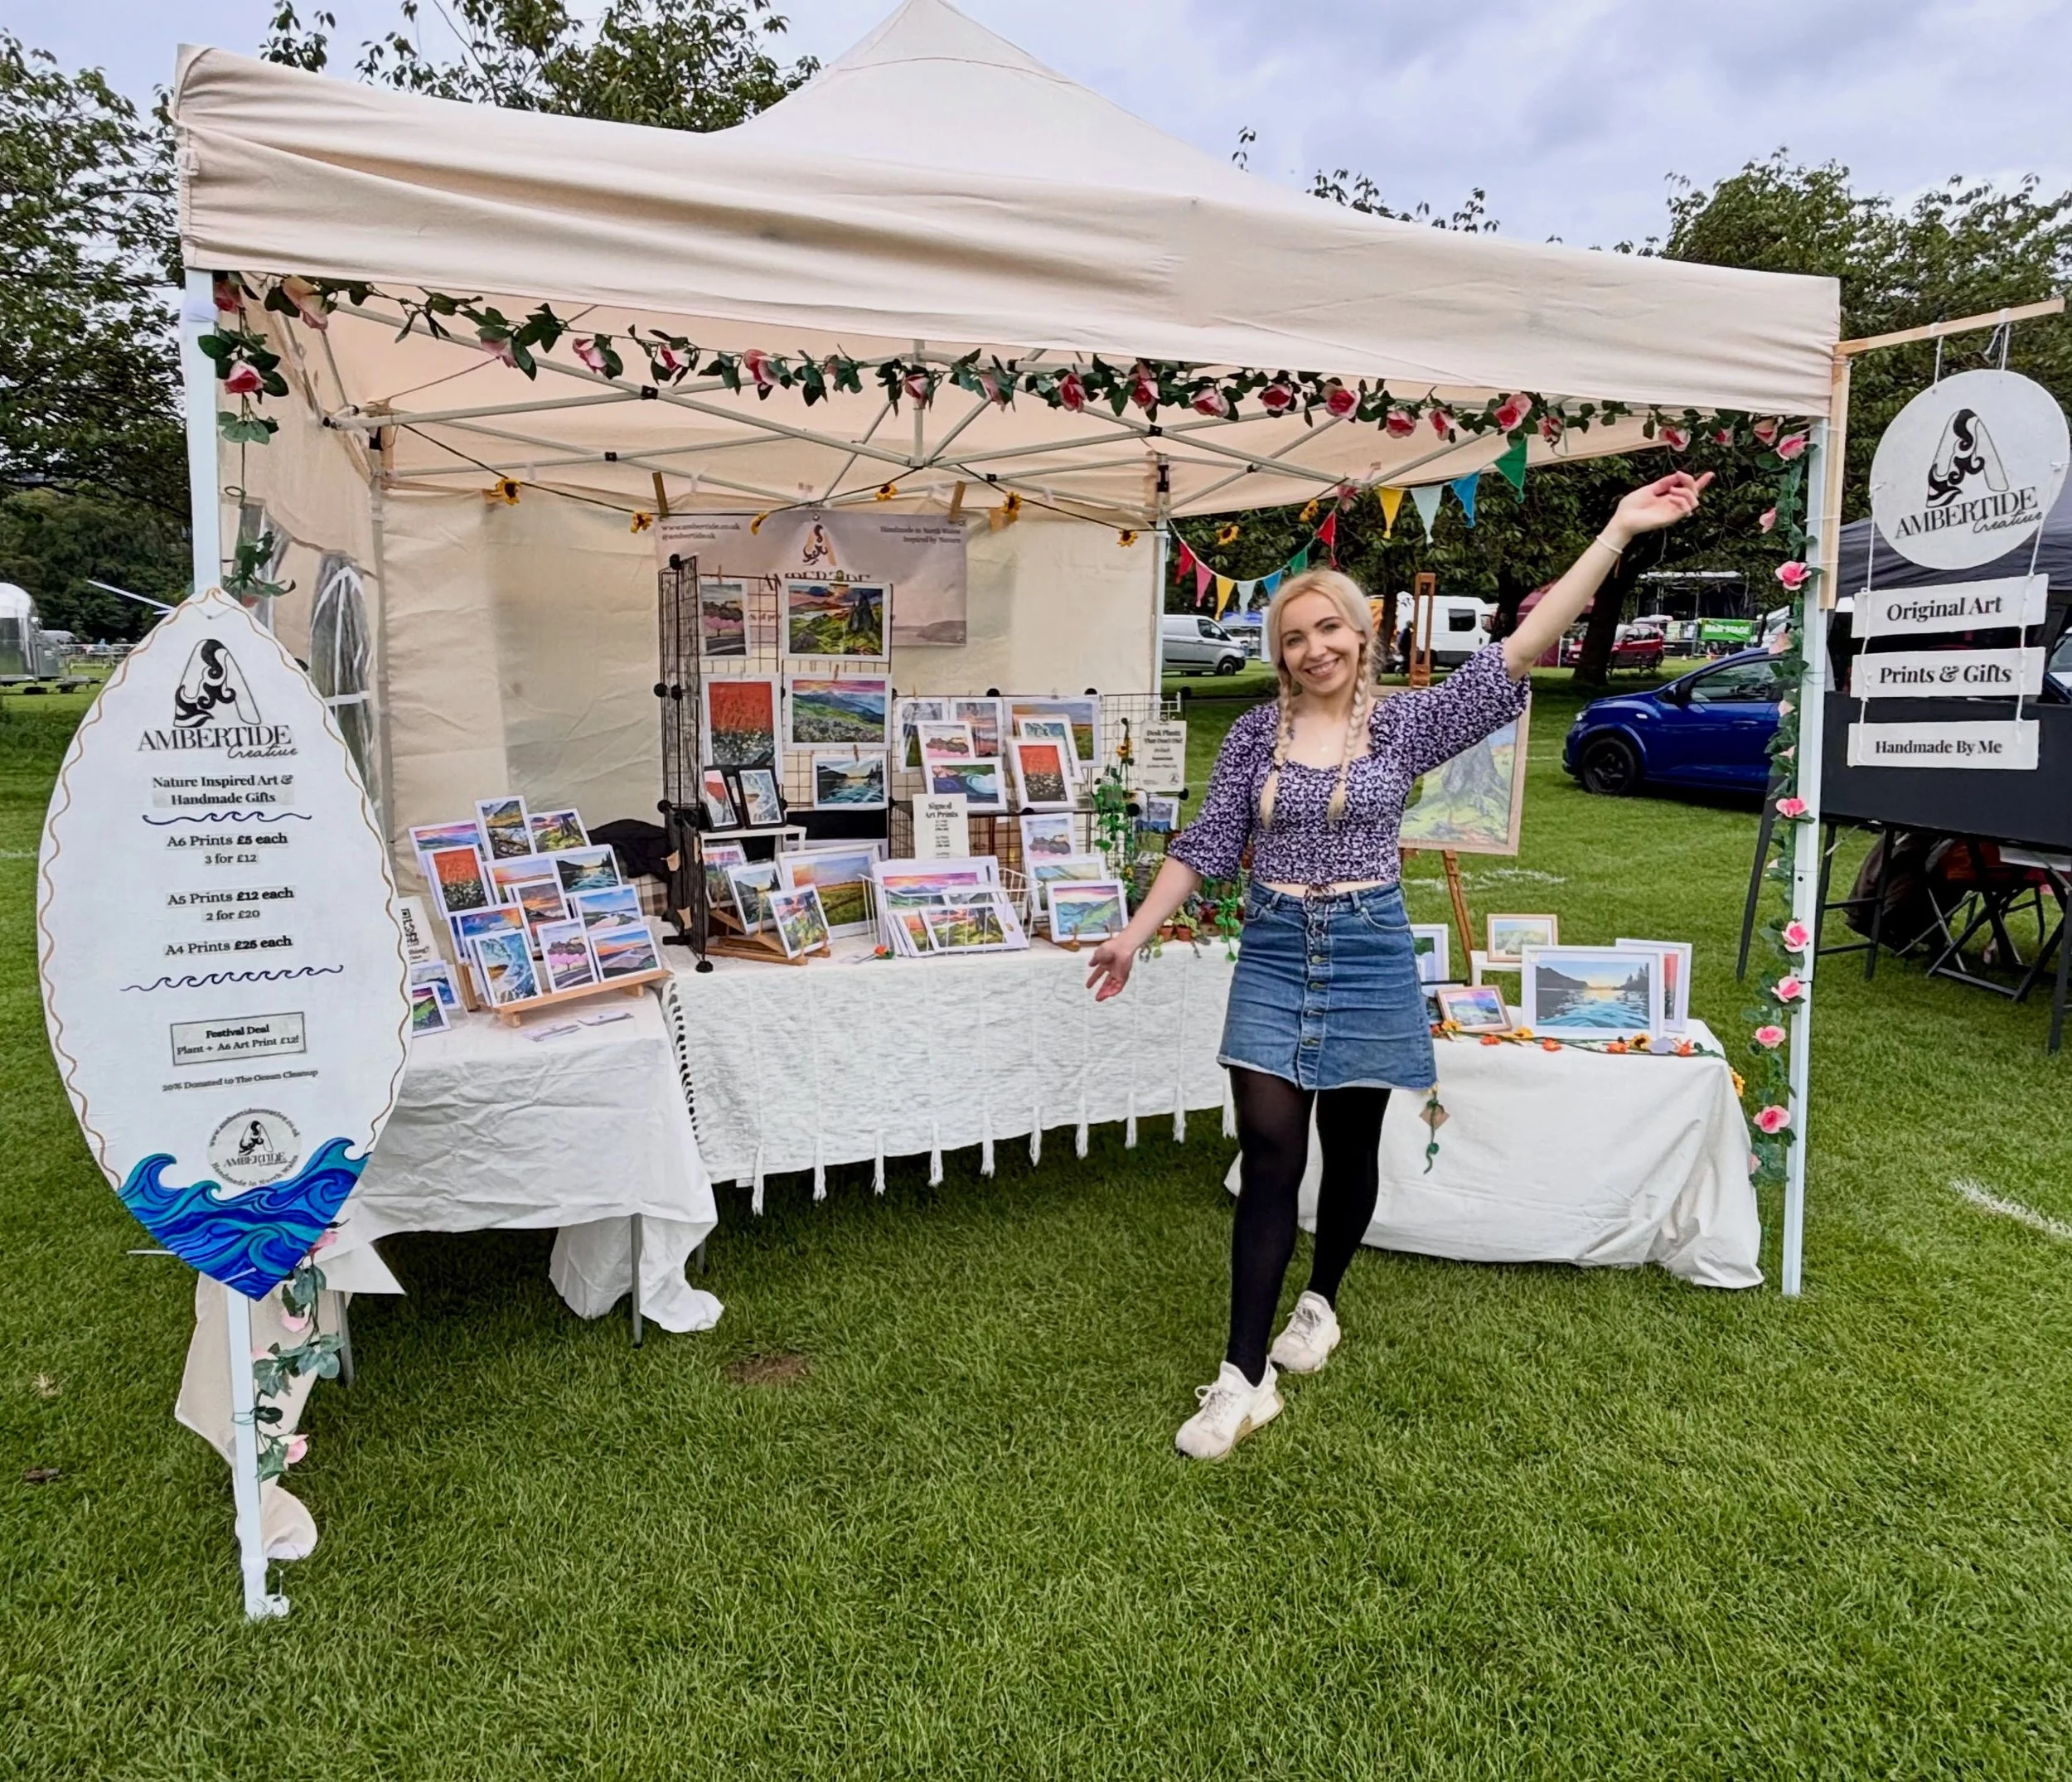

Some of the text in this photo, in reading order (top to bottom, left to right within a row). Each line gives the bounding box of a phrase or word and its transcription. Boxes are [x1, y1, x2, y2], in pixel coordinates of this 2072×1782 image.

[1895, 486, 2037, 539] AMBERTIDE
[1973, 509, 2042, 534] Creative
[1886, 597, 2002, 622] Original Art
[1880, 664, 2012, 683] Prints & Gifts
[138, 724, 292, 751] AMBERTIDE
[228, 744, 298, 759] Creative
[1875, 739, 2002, 756] Handmade By Me
[152, 774, 293, 788] Nature Inspired Art &
[171, 792, 275, 805] Handmade Gifts
[928, 802, 951, 811] Signed
[167, 832, 288, 847] A6 Prints £5 each
[206, 854, 257, 864] 3 for £12
[167, 887, 294, 905] A5 Prints £12 each
[206, 910, 260, 921] 2 for £20
[166, 935, 293, 955] A4 Prints £25 each
[206, 1024, 269, 1039] Festival Deal
[177, 1046, 204, 1055] Plant
[217, 1043, 230, 1051] A6
[233, 1041, 250, 1049] Art
[252, 1038, 277, 1048] Print
[184, 1078, 222, 1089] Donated
[283, 1069, 318, 1078] Cleanup
[224, 1152, 287, 1167] AMBERTIDE
